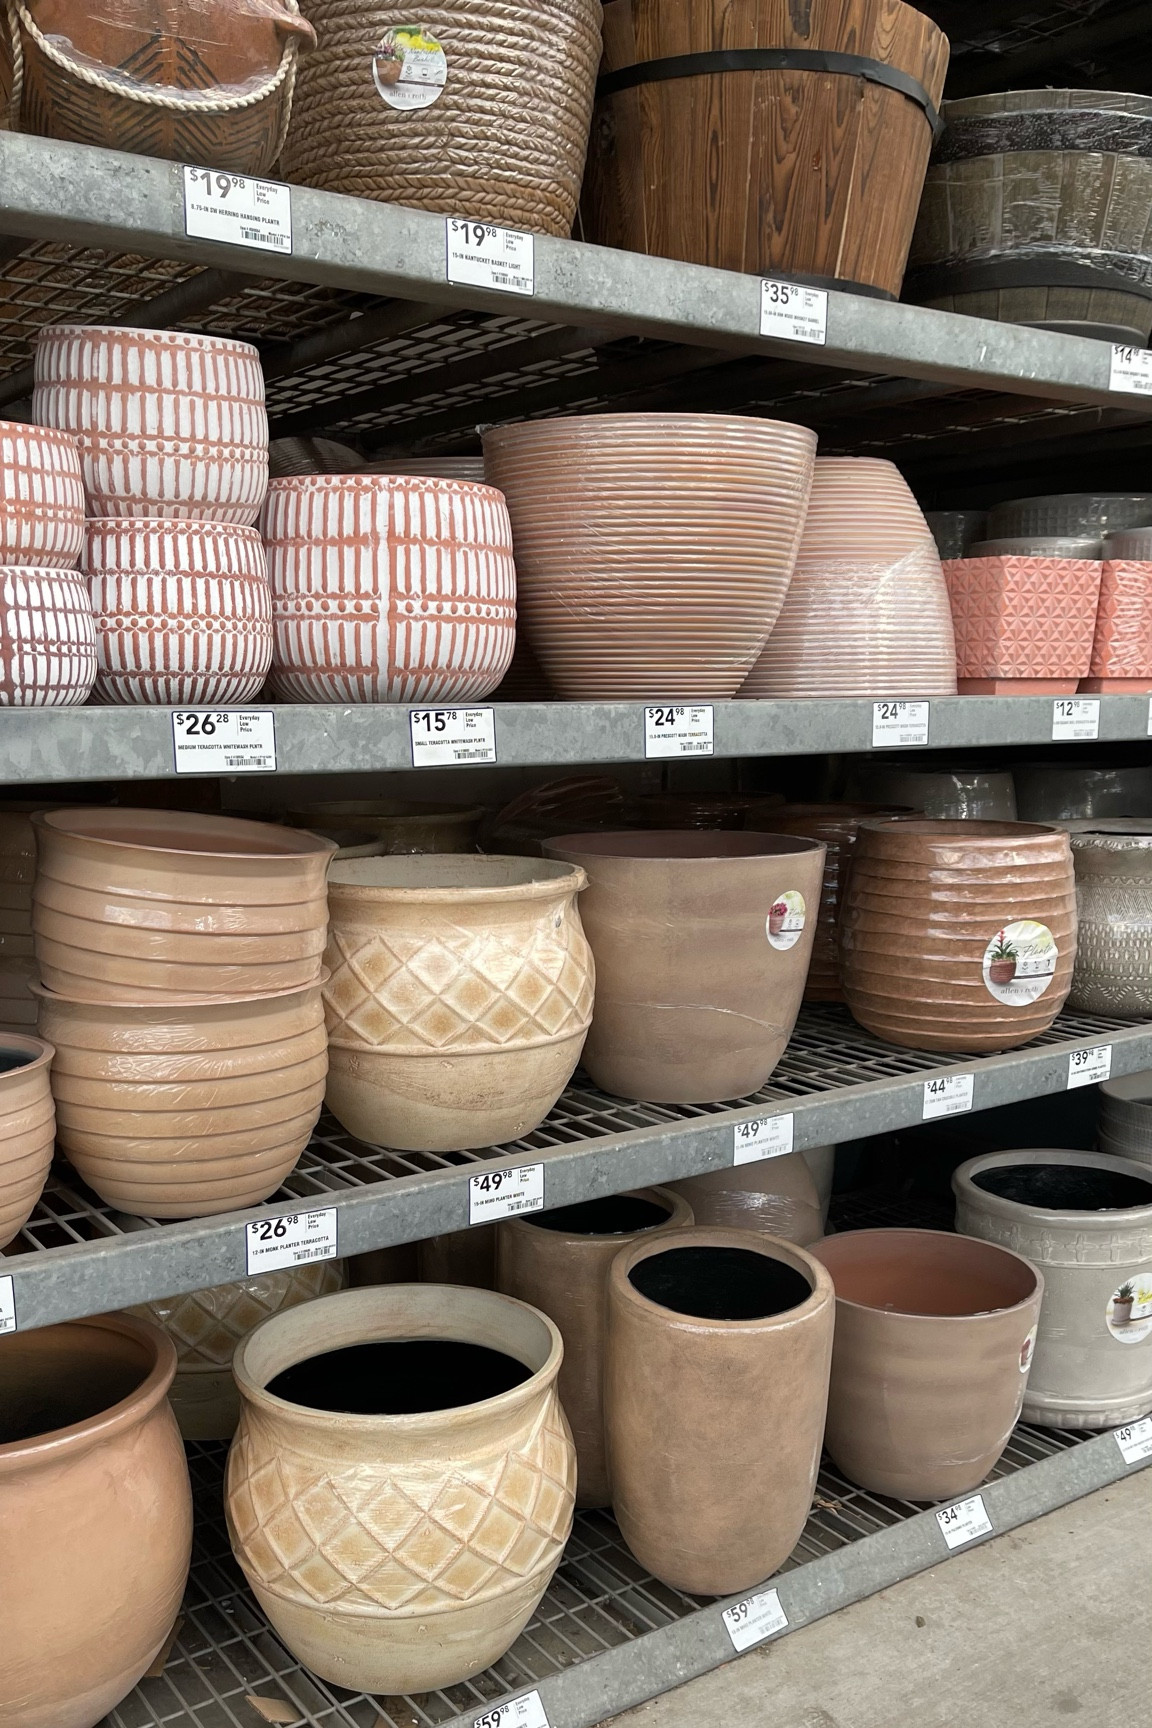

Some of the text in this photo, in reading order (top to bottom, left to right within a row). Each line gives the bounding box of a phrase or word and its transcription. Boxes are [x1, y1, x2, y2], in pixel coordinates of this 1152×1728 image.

[256, 184, 278, 194] Everyday
[219, 209, 239, 218] HERRING
[240, 213, 260, 222] HANGING
[262, 217, 279, 225] PLANTR
[506, 232, 523, 241] Everyday
[465, 255, 490, 264] NANTUCKET
[301, 1236, 329, 1246] TERRACOTTA
